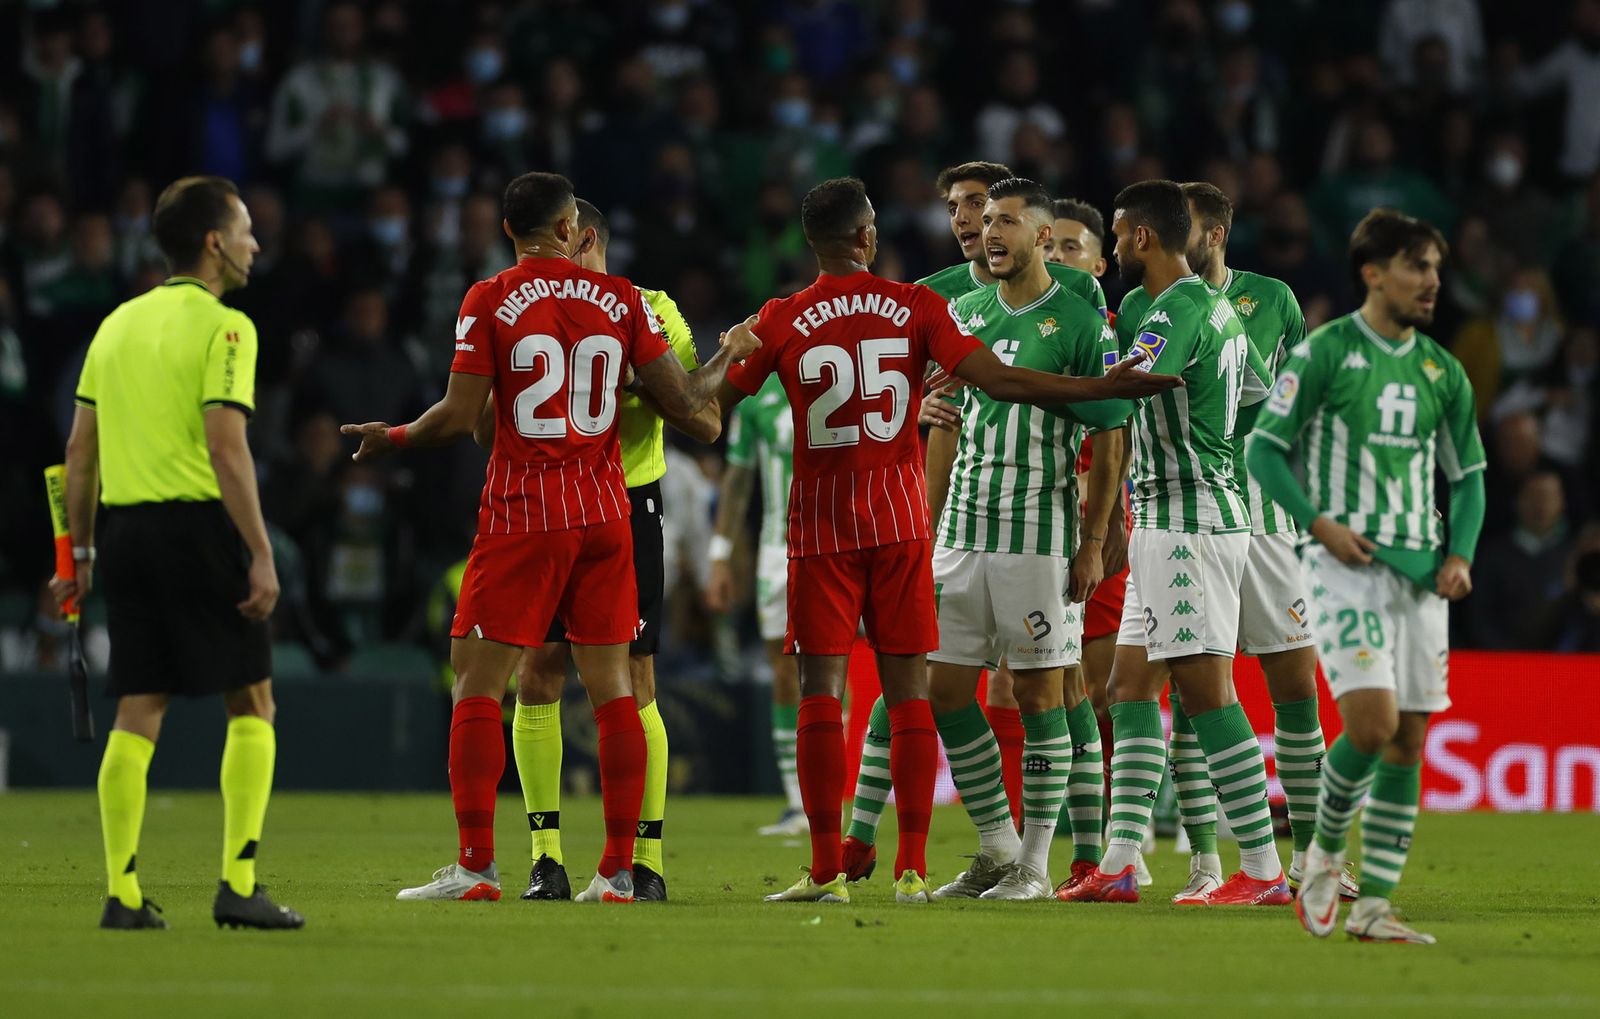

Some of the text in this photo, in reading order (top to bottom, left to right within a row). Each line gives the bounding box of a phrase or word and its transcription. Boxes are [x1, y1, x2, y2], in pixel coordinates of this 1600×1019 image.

[792, 293, 911, 337] FERNANDO
[511, 334, 623, 438] 20
[798, 338, 910, 449] 25
[1376, 382, 1417, 436] fi
[1336, 608, 1385, 649] 28
